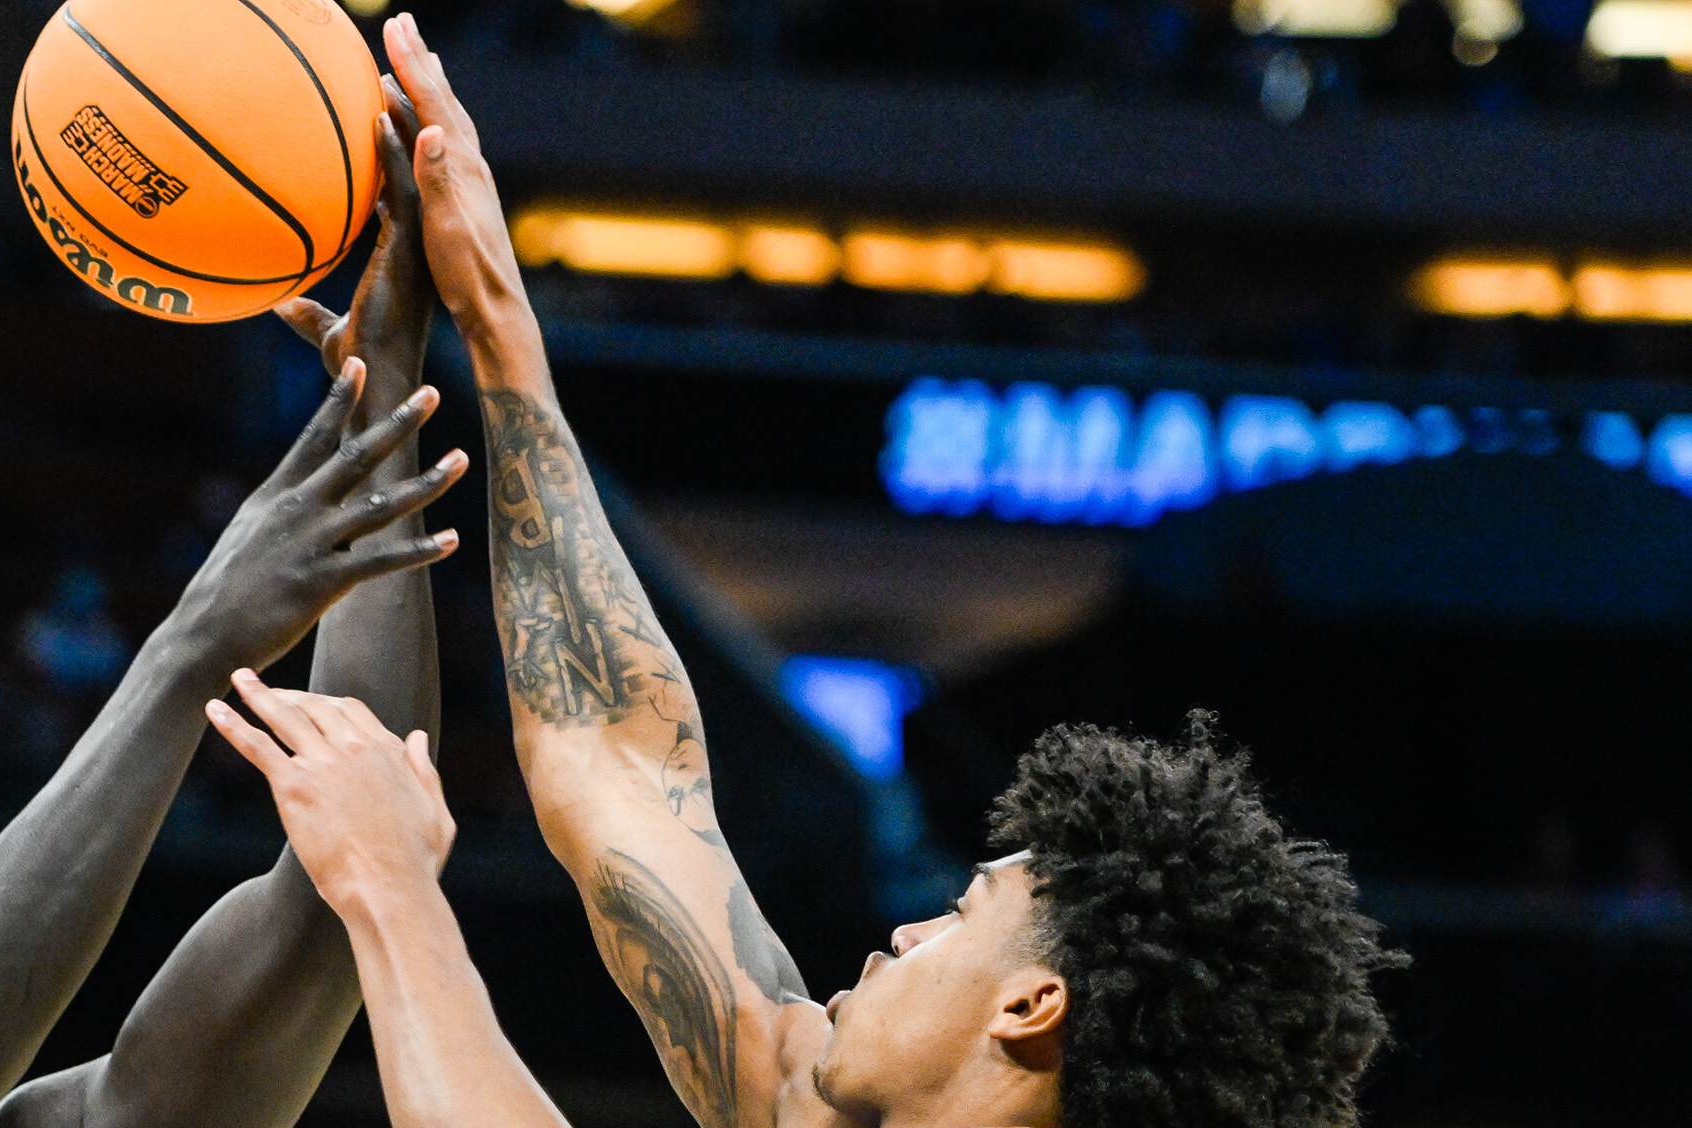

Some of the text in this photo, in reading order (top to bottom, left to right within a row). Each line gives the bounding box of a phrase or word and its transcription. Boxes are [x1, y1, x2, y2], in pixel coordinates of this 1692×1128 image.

[75, 106, 150, 184] MADNESS
[82, 144, 145, 204] MARCH
[79, 233, 108, 258] EVO
